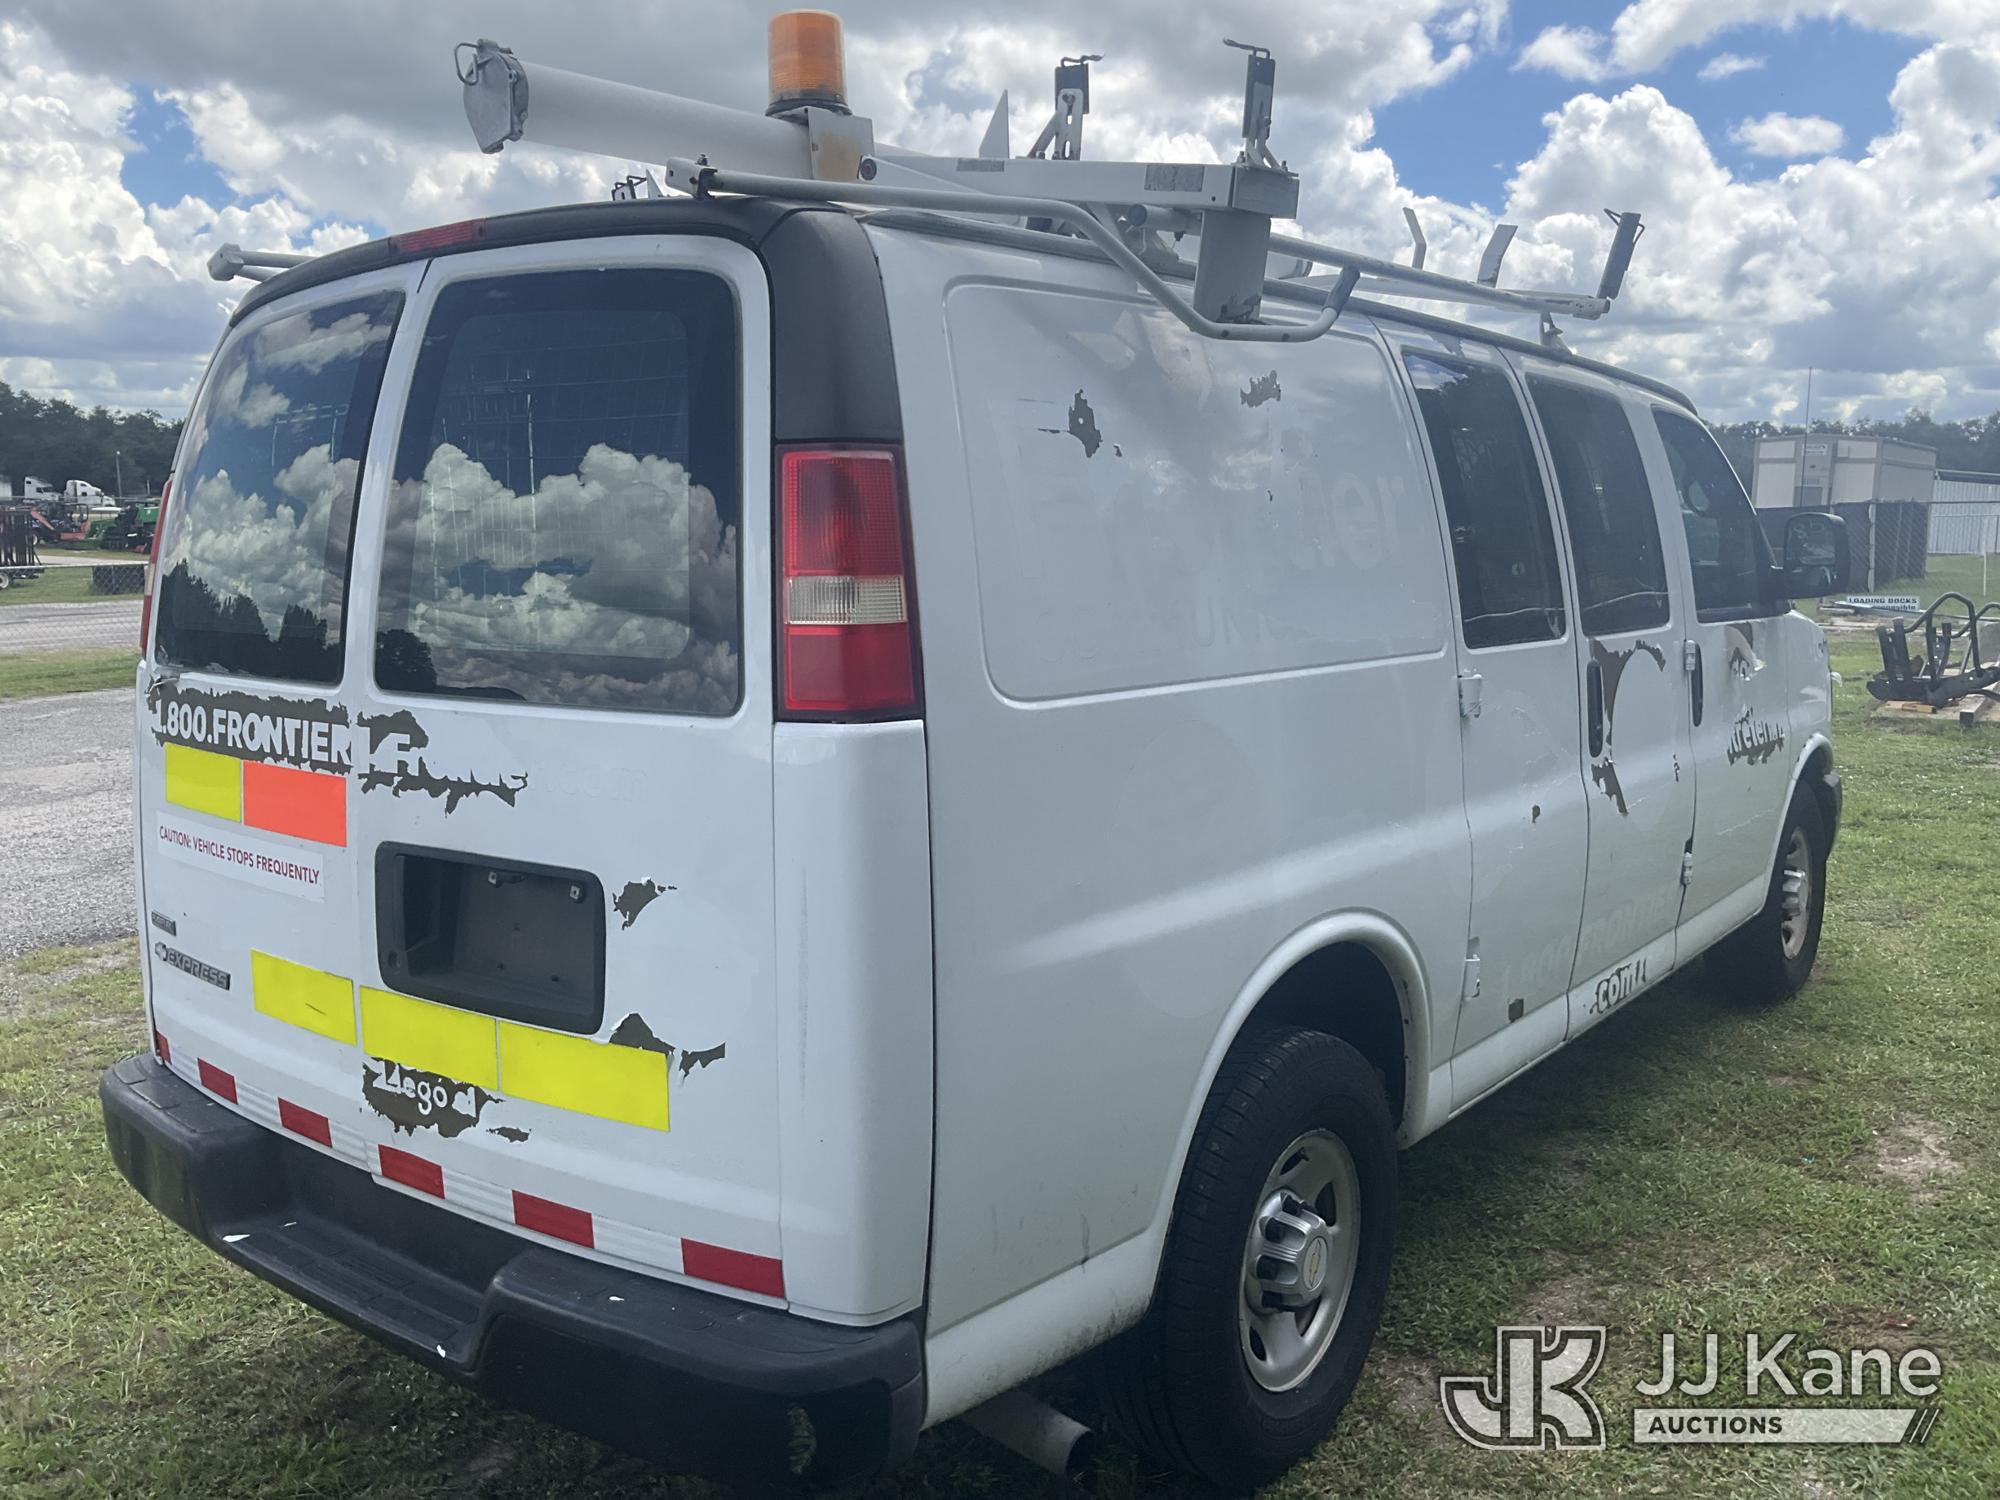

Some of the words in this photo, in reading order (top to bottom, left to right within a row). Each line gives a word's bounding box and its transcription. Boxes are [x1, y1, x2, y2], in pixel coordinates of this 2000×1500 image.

[159, 825, 192, 849] CAUTION:
[192, 836, 225, 860] VEHICLE
[227, 846, 254, 868] STOPS
[256, 854, 320, 885] FREQUENTLY
